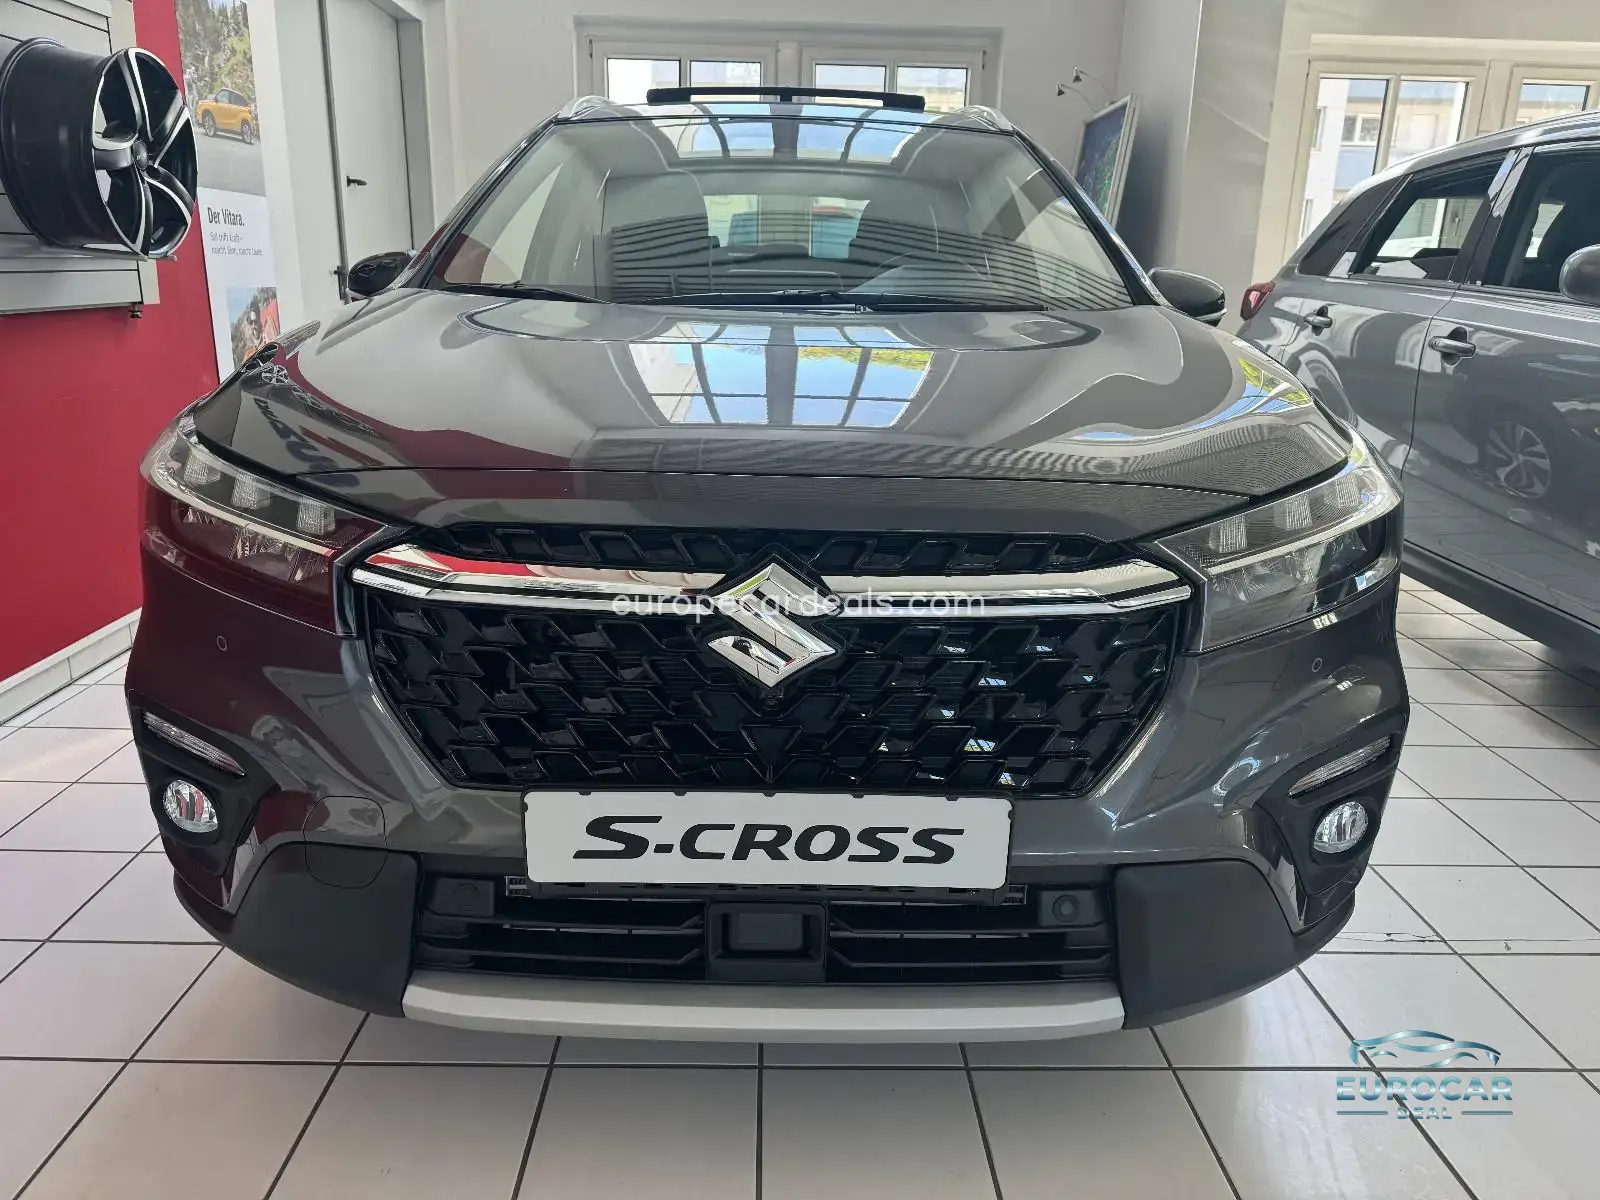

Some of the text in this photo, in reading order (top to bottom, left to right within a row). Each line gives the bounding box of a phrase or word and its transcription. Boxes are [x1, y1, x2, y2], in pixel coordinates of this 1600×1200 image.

[207, 206, 245, 226] Der Vitara.
[572, 815, 965, 864] S-CROSS
